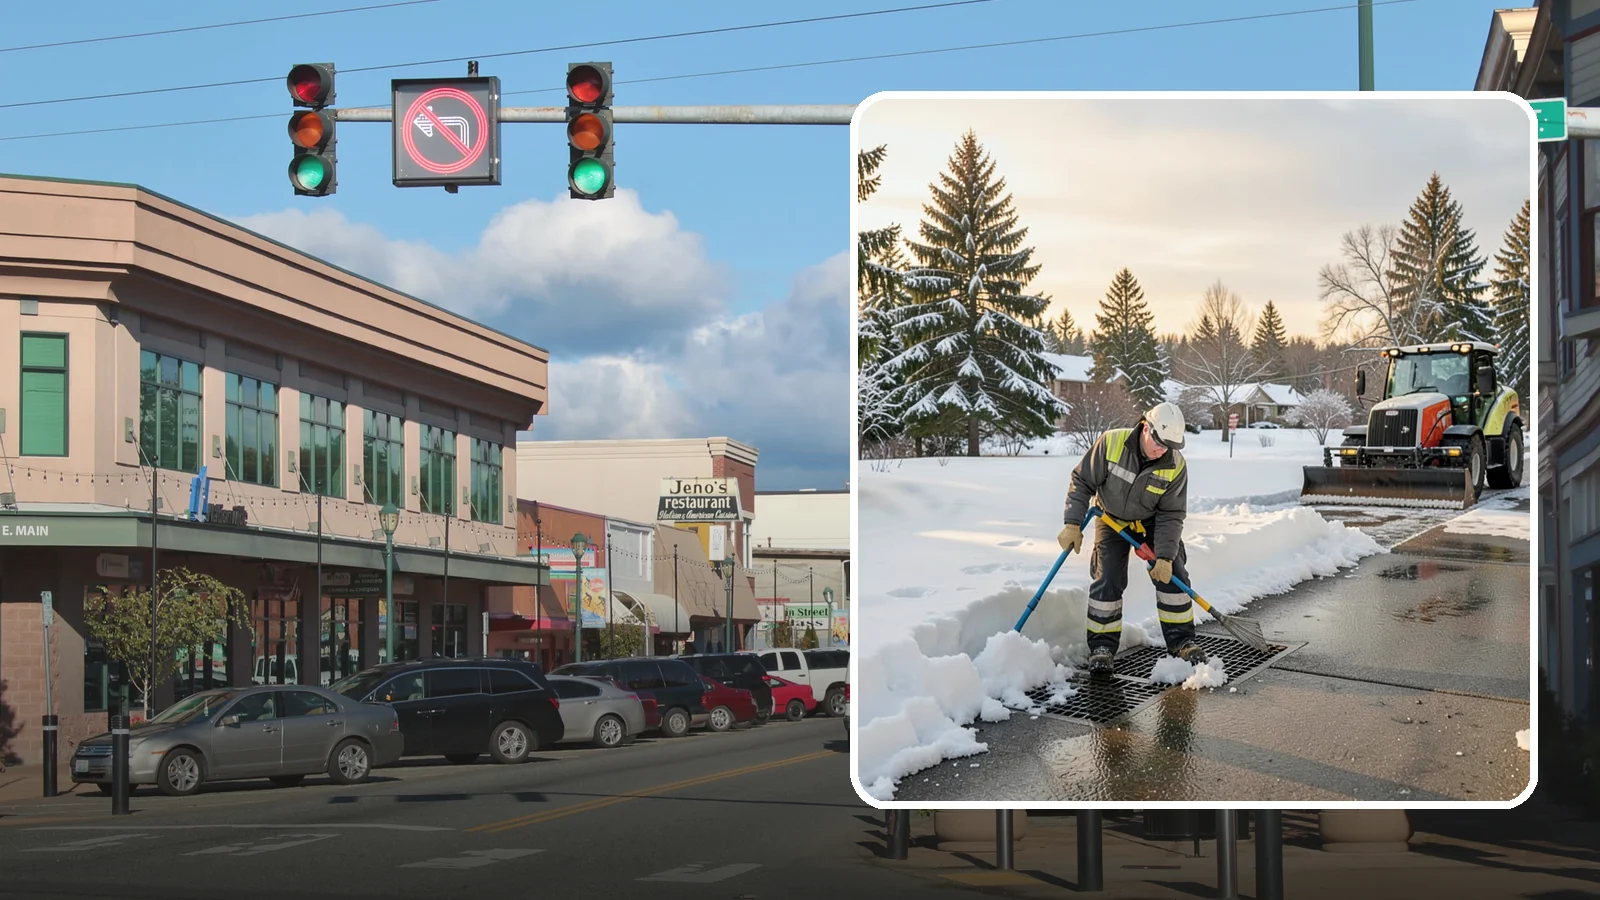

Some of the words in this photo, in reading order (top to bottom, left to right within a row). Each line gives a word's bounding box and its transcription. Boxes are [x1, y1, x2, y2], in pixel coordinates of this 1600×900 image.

[669, 479, 728, 495] Jeno's
[664, 496, 731, 509] restaurant
[658, 509, 682, 520] Italian
[686, 509, 715, 520] American
[715, 509, 738, 520] Cuisine
[2, 525, 13, 536] E.
[15, 525, 49, 536] MAIN
[797, 607, 829, 617] Street
